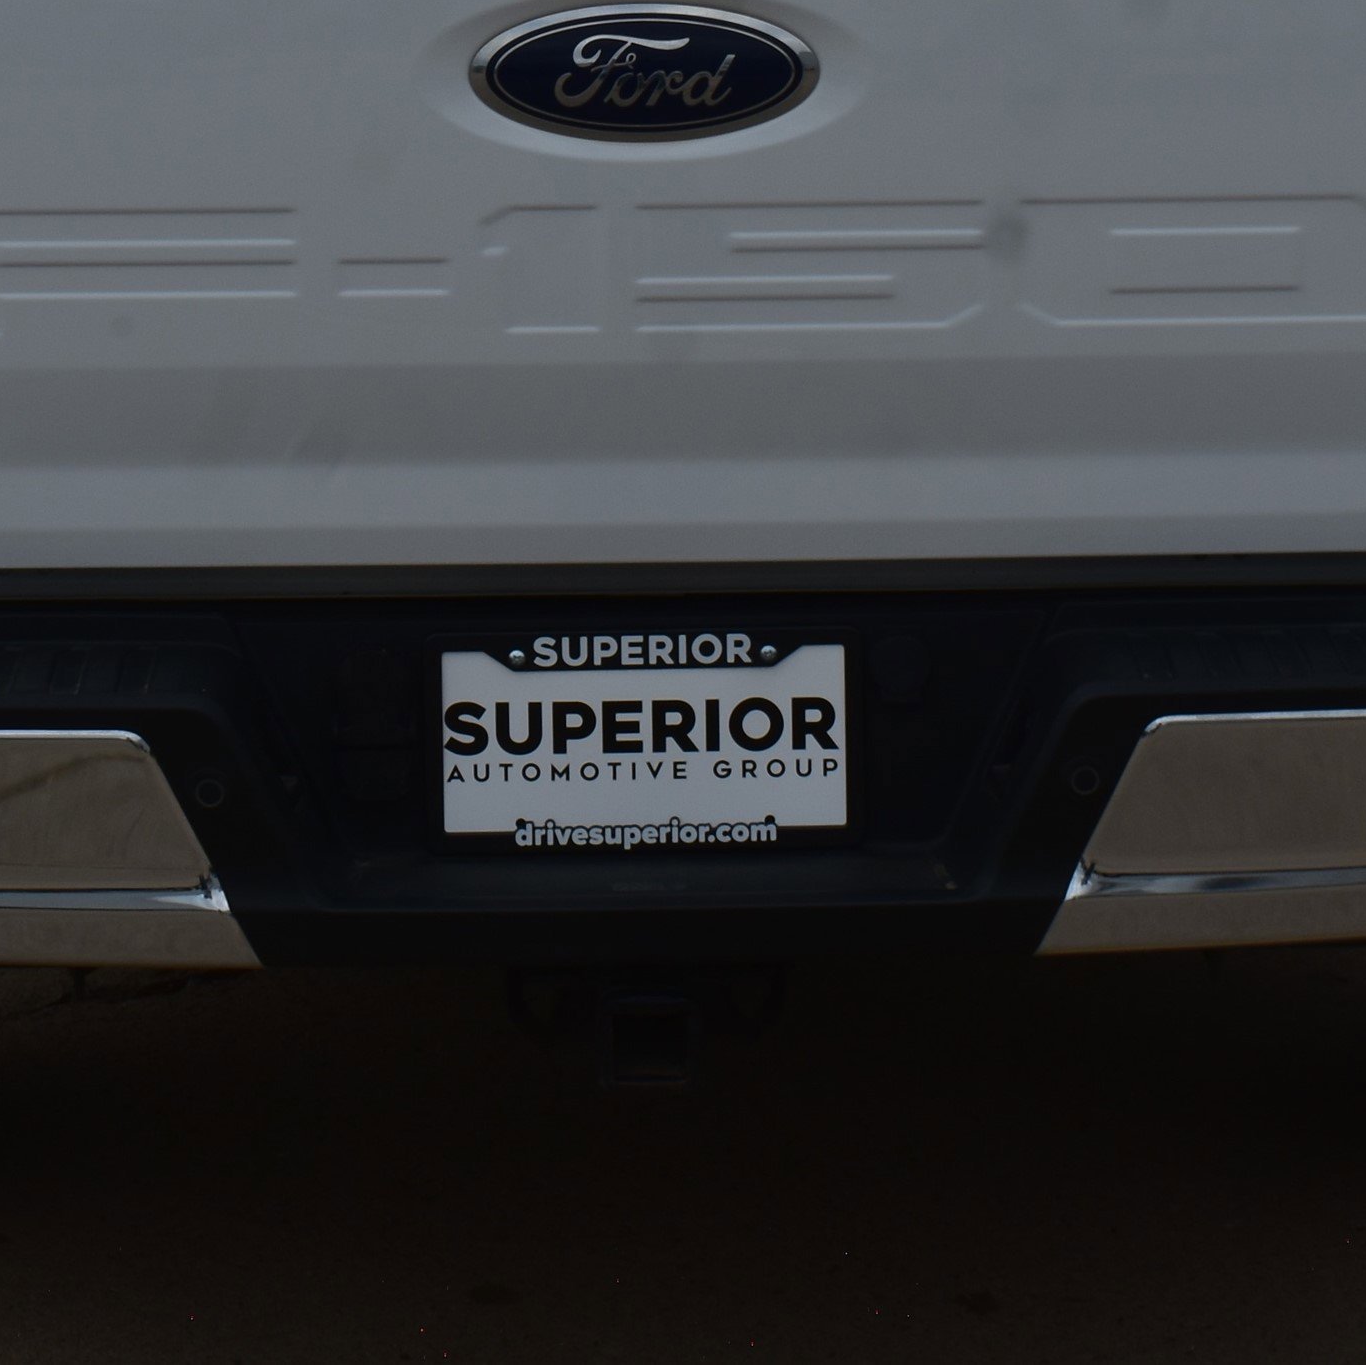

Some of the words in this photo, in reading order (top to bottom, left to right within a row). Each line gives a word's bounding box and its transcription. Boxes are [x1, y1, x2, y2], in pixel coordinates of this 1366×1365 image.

[554, 34, 736, 107] Ford
[533, 633, 752, 668] SUPERIOR
[443, 696, 840, 756] SUPERIOR
[446, 761, 688, 783] AUTOMOTIVE
[713, 758, 839, 779] GROUP
[514, 818, 778, 850] drivesuperior.com
